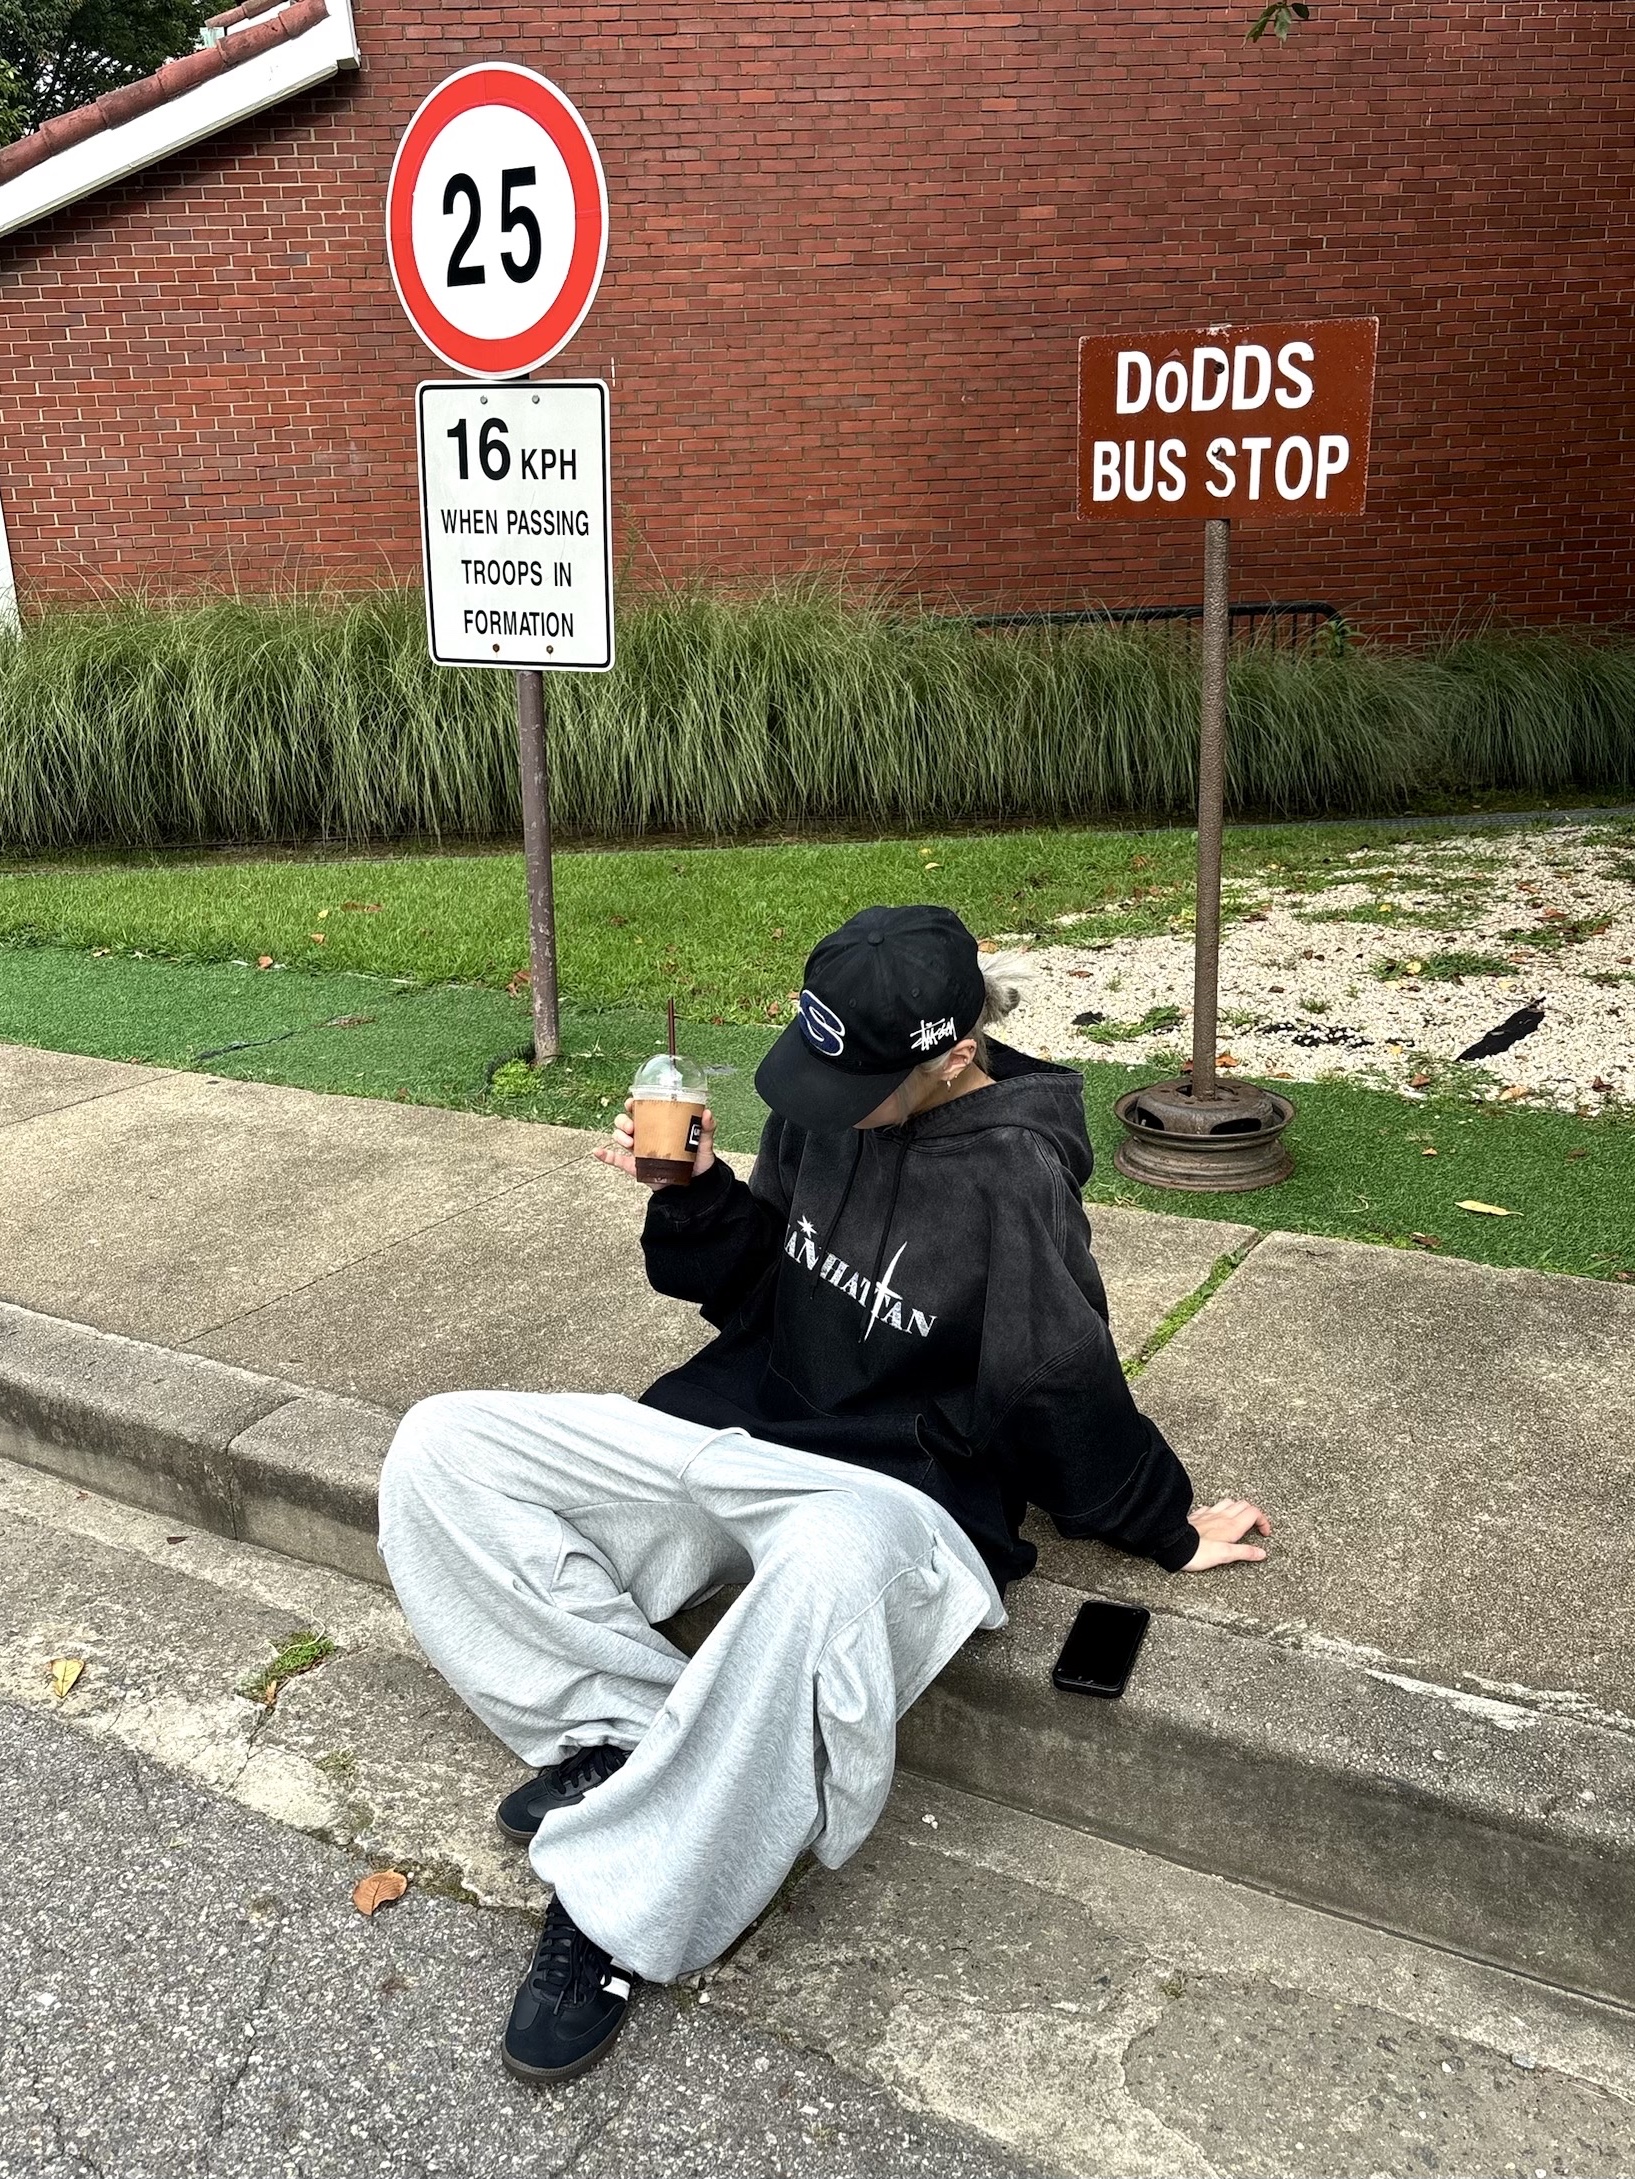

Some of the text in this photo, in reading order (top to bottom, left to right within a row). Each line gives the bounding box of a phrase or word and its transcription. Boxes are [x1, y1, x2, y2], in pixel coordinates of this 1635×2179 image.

[442, 165, 542, 288] 25
[447, 417, 577, 481] 16 KPH
[1092, 435, 1350, 502] BUS STOP
[441, 509, 589, 537] WHEN PASSING
[461, 559, 572, 587] TROOPS IN
[463, 609, 574, 638] FORMATION
[784, 1224, 938, 1339] ANHATTAN
